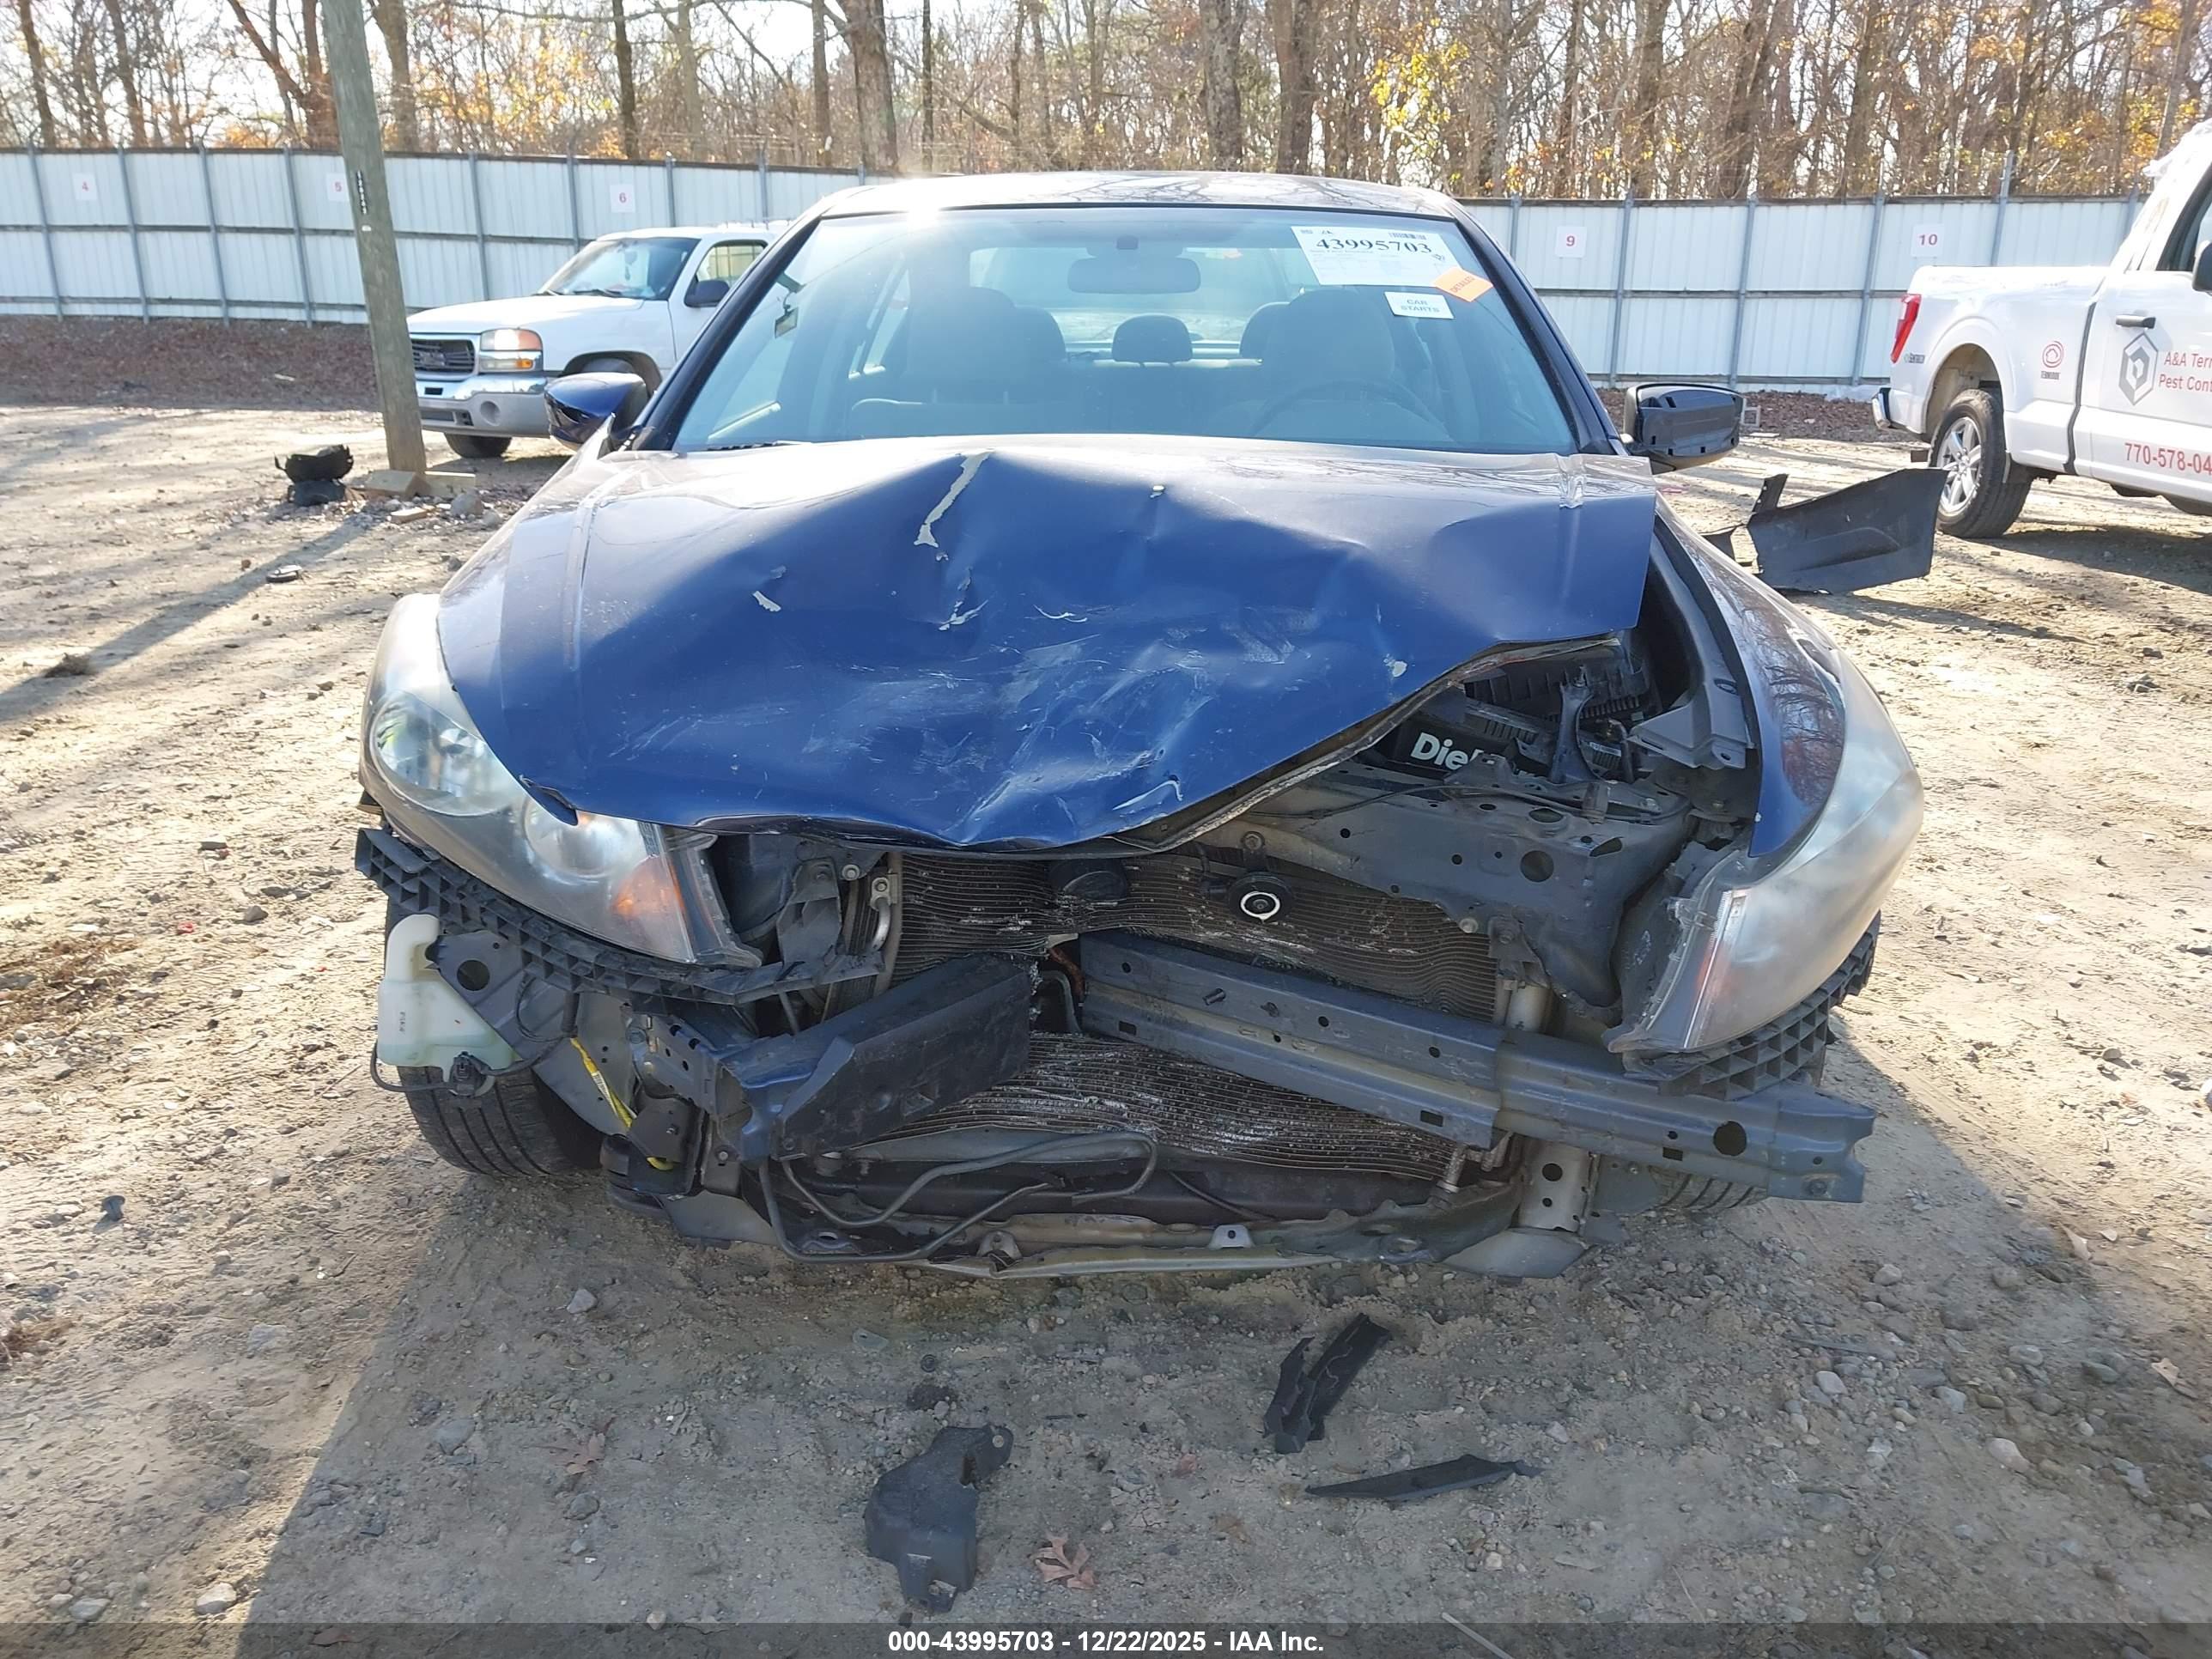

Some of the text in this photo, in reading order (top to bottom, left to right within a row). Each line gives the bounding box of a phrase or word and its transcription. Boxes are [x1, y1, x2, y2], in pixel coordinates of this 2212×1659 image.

[82, 181, 89, 191] 4
[334, 181, 343, 192] 5
[618, 191, 627, 204] 6
[1316, 238, 1432, 254] 43995703
[1566, 235, 1576, 247] 9
[1919, 234, 1938, 246] 10
[1401, 305, 1440, 313] STARTS
[2164, 351, 2187, 367] A&A
[2159, 374, 2184, 390] Pest
